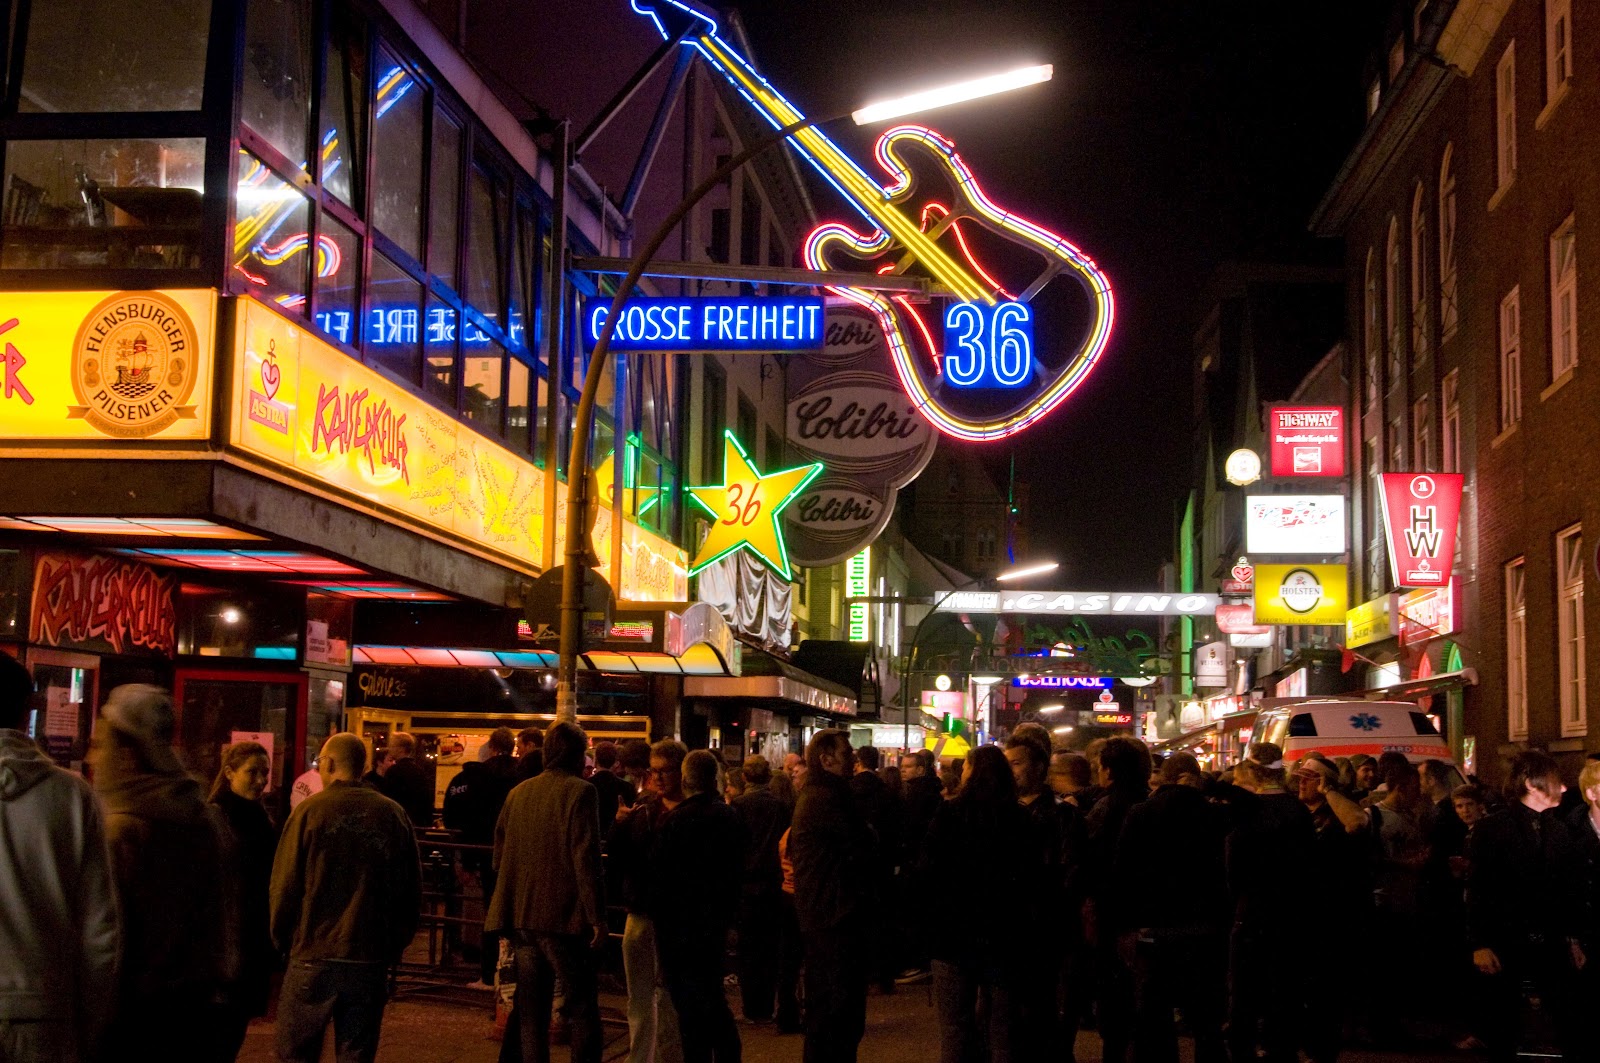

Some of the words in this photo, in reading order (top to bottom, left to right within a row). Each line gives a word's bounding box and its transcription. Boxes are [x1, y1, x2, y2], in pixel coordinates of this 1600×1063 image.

[86, 303, 185, 353] FLENSBURGER
[703, 305, 820, 340] FREIHEIT
[946, 303, 1031, 386] 36
[93, 389, 173, 420] PILSENER
[251, 398, 287, 428] ASTRA
[796, 397, 918, 439] Colibri
[1278, 413, 1334, 427] HIGHWAY
[722, 483, 761, 526] 36
[797, 495, 874, 522] Colibri
[1016, 593, 1208, 611] CASINO
[1281, 587, 1320, 595] HOLSTEN
